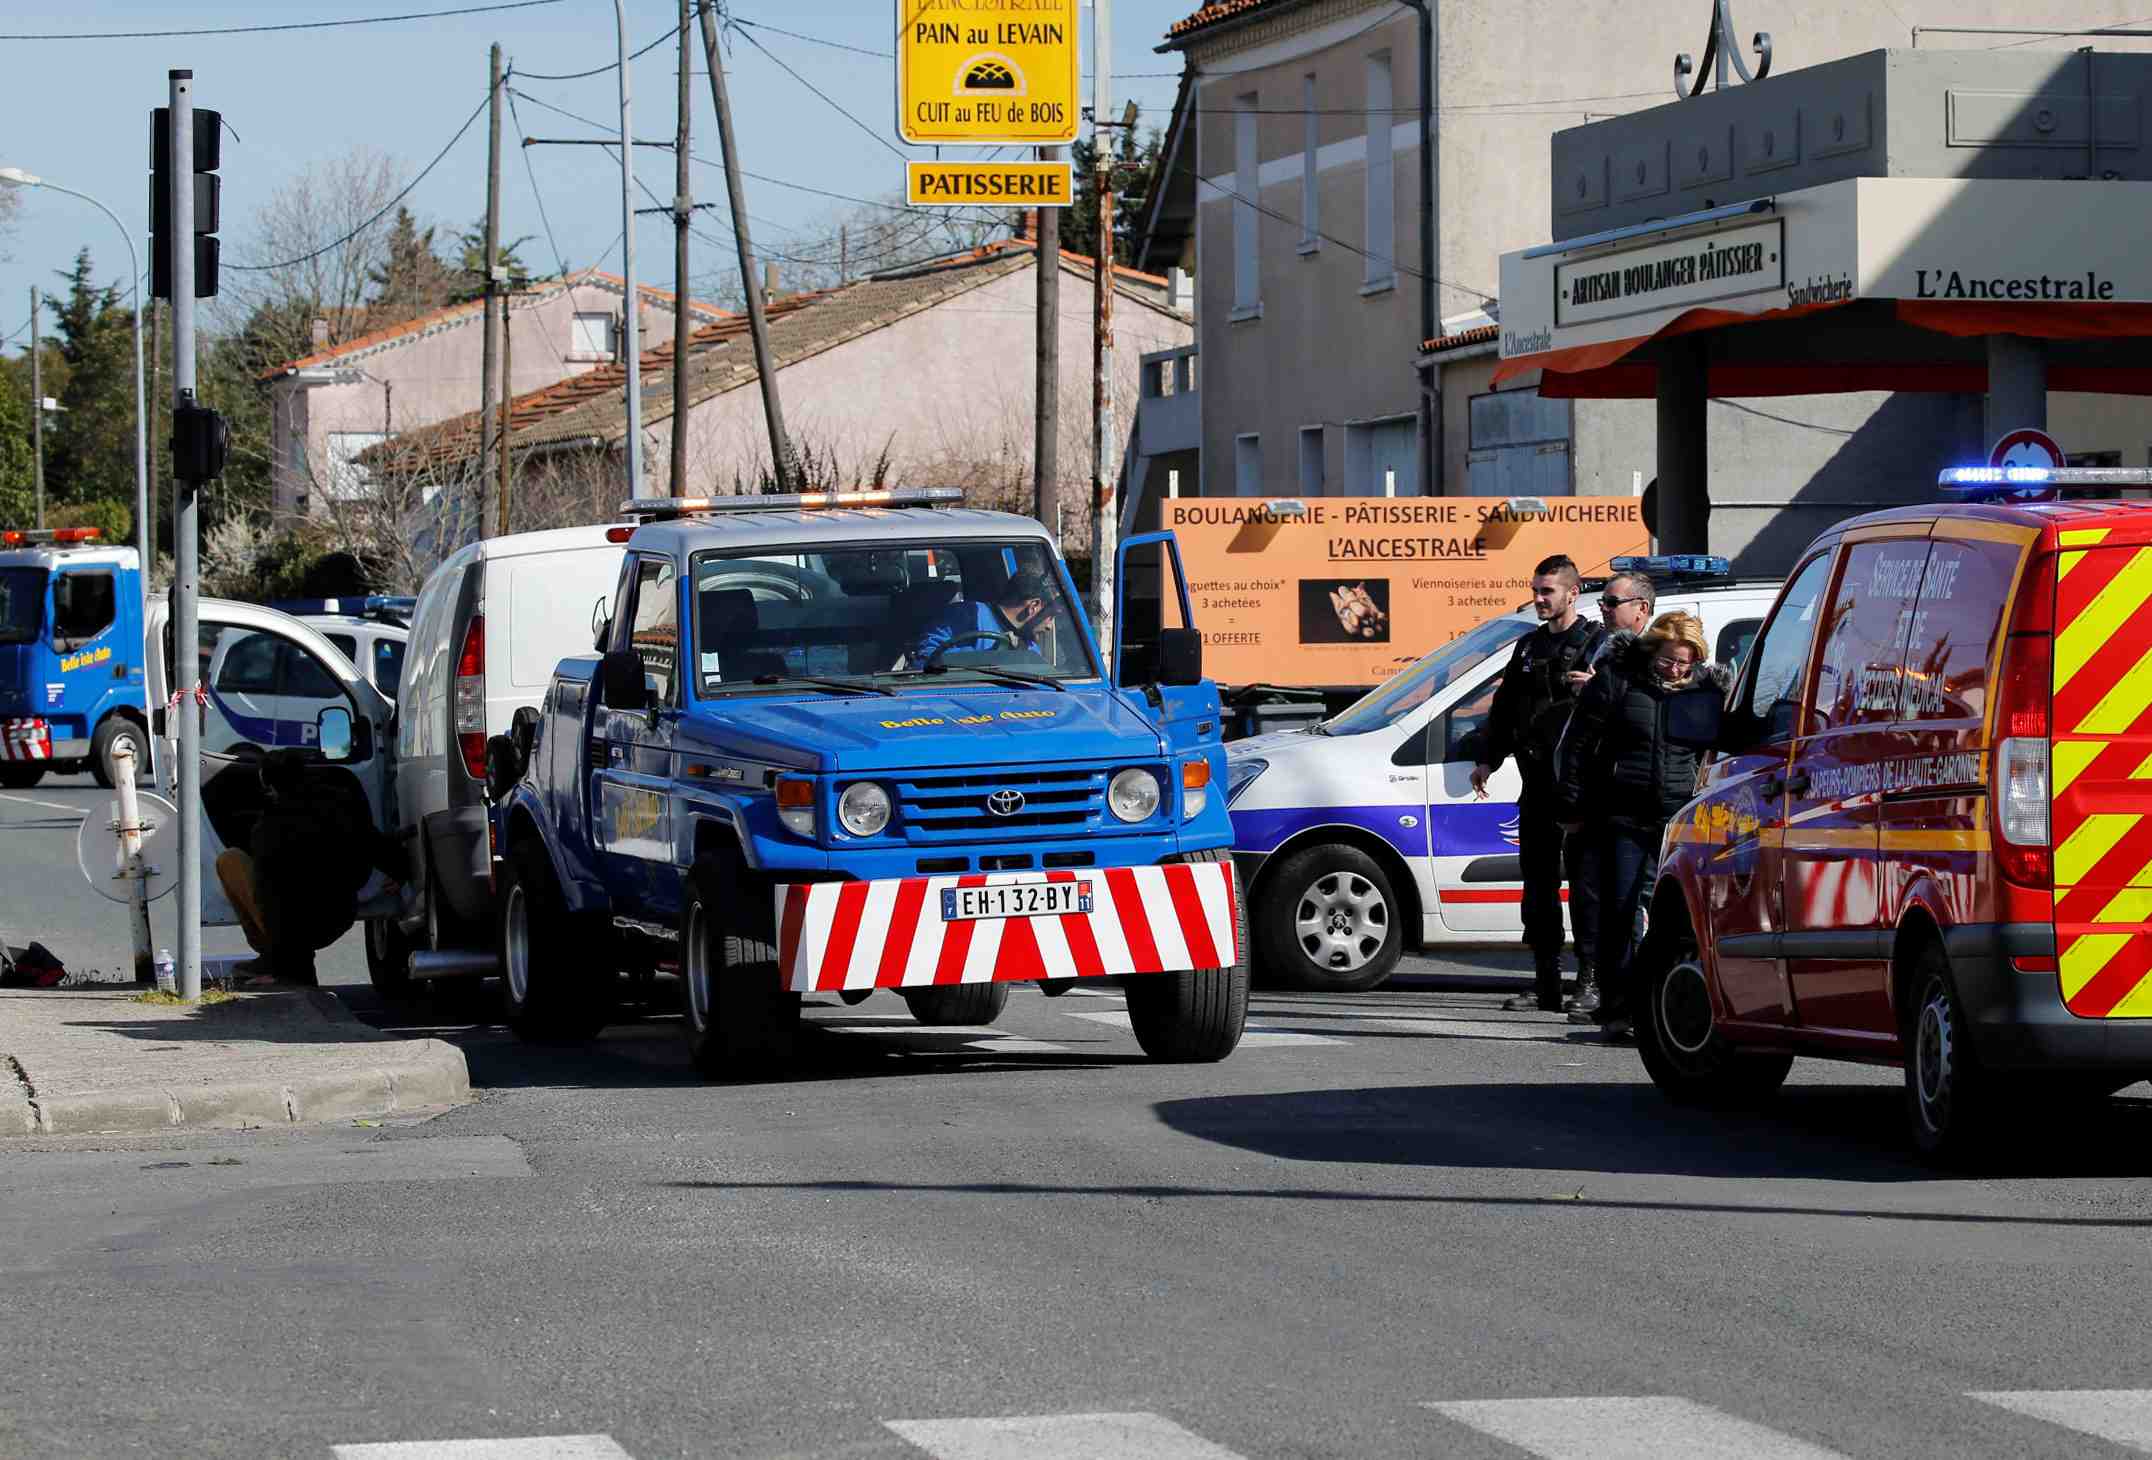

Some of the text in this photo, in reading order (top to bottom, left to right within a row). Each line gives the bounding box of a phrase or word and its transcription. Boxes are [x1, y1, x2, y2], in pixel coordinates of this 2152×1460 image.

[916, 23, 1063, 44] PAIN au LEVAIN
[917, 101, 1064, 122] CUIT au FEU de BOIS
[919, 174, 1061, 195] PATISSERIE
[1572, 242, 1763, 305] ARTISAN BOULANGER PÂTISSIER
[1788, 271, 1852, 307] Sandwicherie
[1916, 269, 2114, 300] L'Ancestrale
[1173, 505, 1325, 525] BOULANGERIE
[1345, 502, 1457, 523] PÂTISSERIE
[1477, 504, 1638, 523] SANDWICHERIE
[1328, 538, 1487, 558] L'ANCESTRALE
[1187, 580, 1231, 593] guettes
[1233, 581, 1247, 591] au
[1412, 579, 1487, 589] Viennoiseries
[1489, 581, 1503, 589] au
[1202, 598, 1209, 608] 3
[1448, 596, 1455, 606] 3
[1212, 632, 1261, 643] OFFERTE
[963, 886, 1072, 915] EH-132-BY
[1079, 897, 1091, 911] 11
